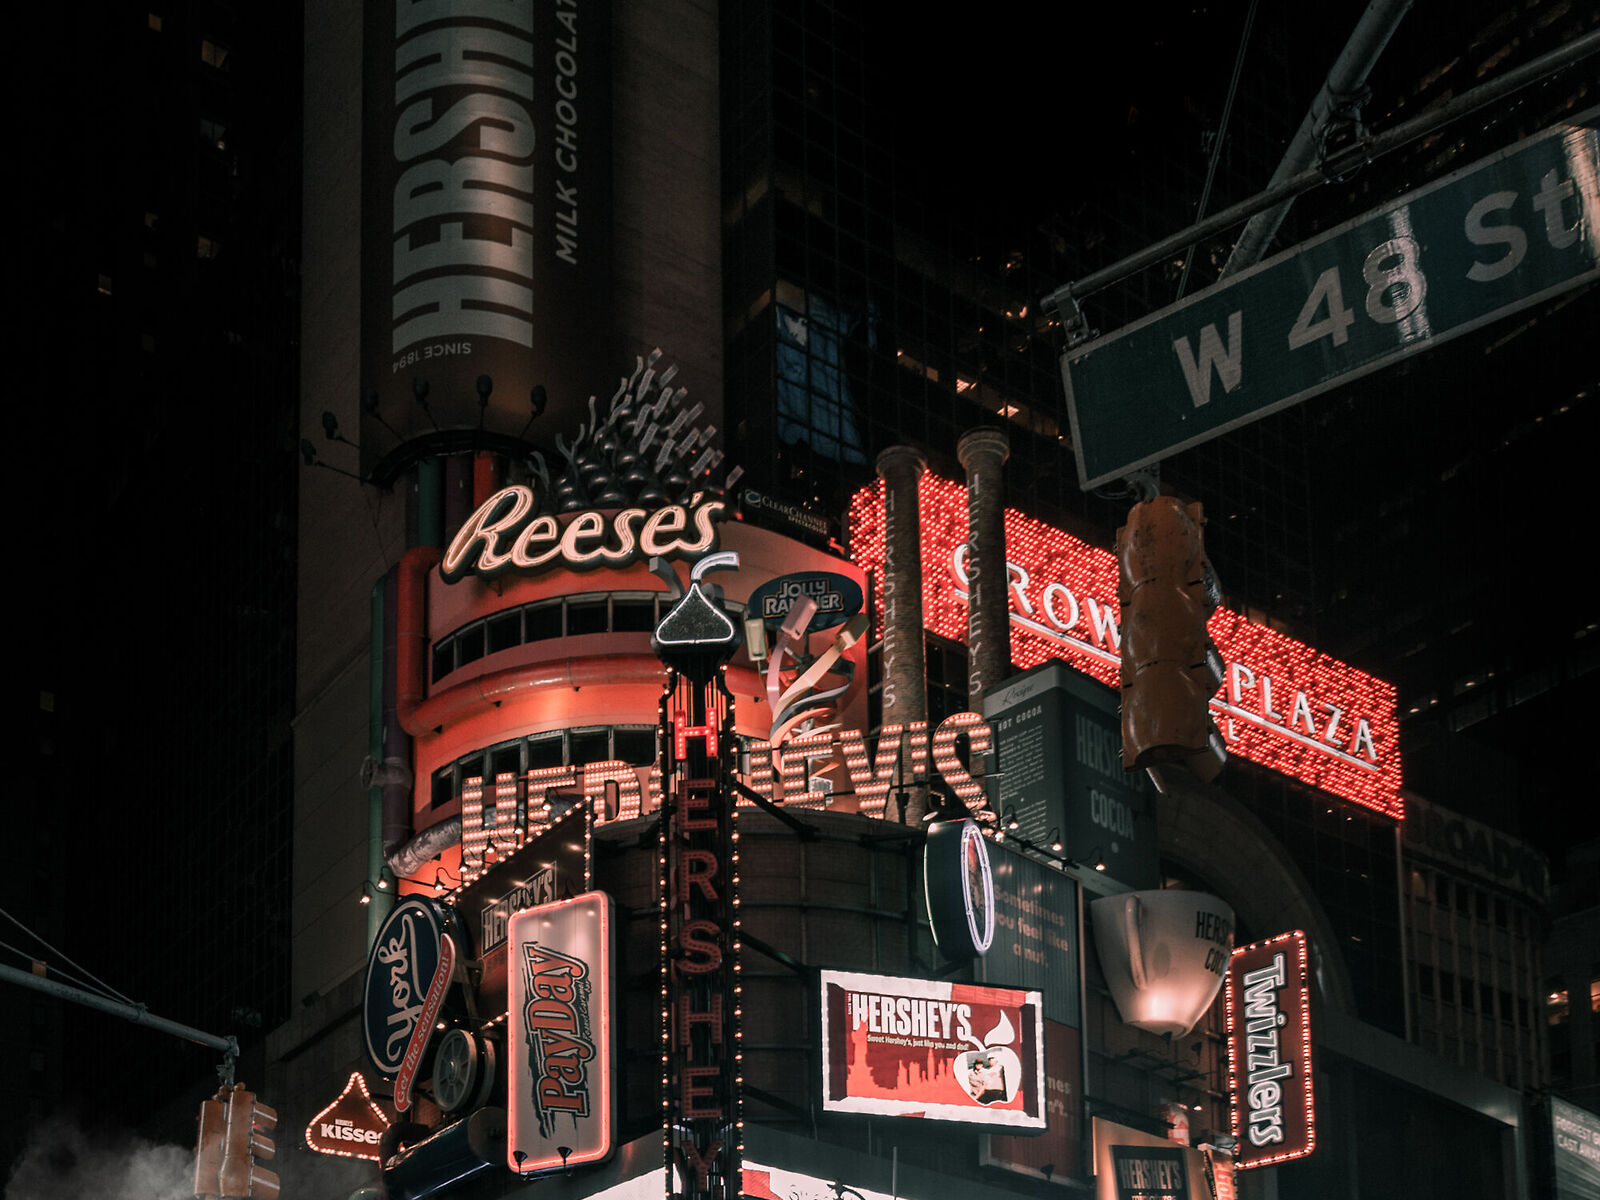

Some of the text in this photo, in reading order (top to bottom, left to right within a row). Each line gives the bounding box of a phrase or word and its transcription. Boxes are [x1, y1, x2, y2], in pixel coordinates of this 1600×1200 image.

[555, 0, 578, 265] MILK CHOCOLA
[1173, 167, 1584, 409] W 48 St
[392, 342, 472, 374] SINCE 1894
[442, 484, 725, 575] Reese's
[779, 581, 826, 599] JOLLY
[1016, 705, 1043, 724] COCOA
[1232, 662, 1377, 760] PLAZA
[1090, 789, 1134, 840] COCOA
[378, 914, 425, 1062] York
[405, 1044, 421, 1071] the
[417, 955, 449, 1043] sensation!
[524, 942, 595, 1117] PayDay
[852, 993, 971, 1040] HERSHEY'S
[1243, 952, 1293, 1147] Twizzlers
[1120, 1159, 1182, 1189] HERSHEY'S
